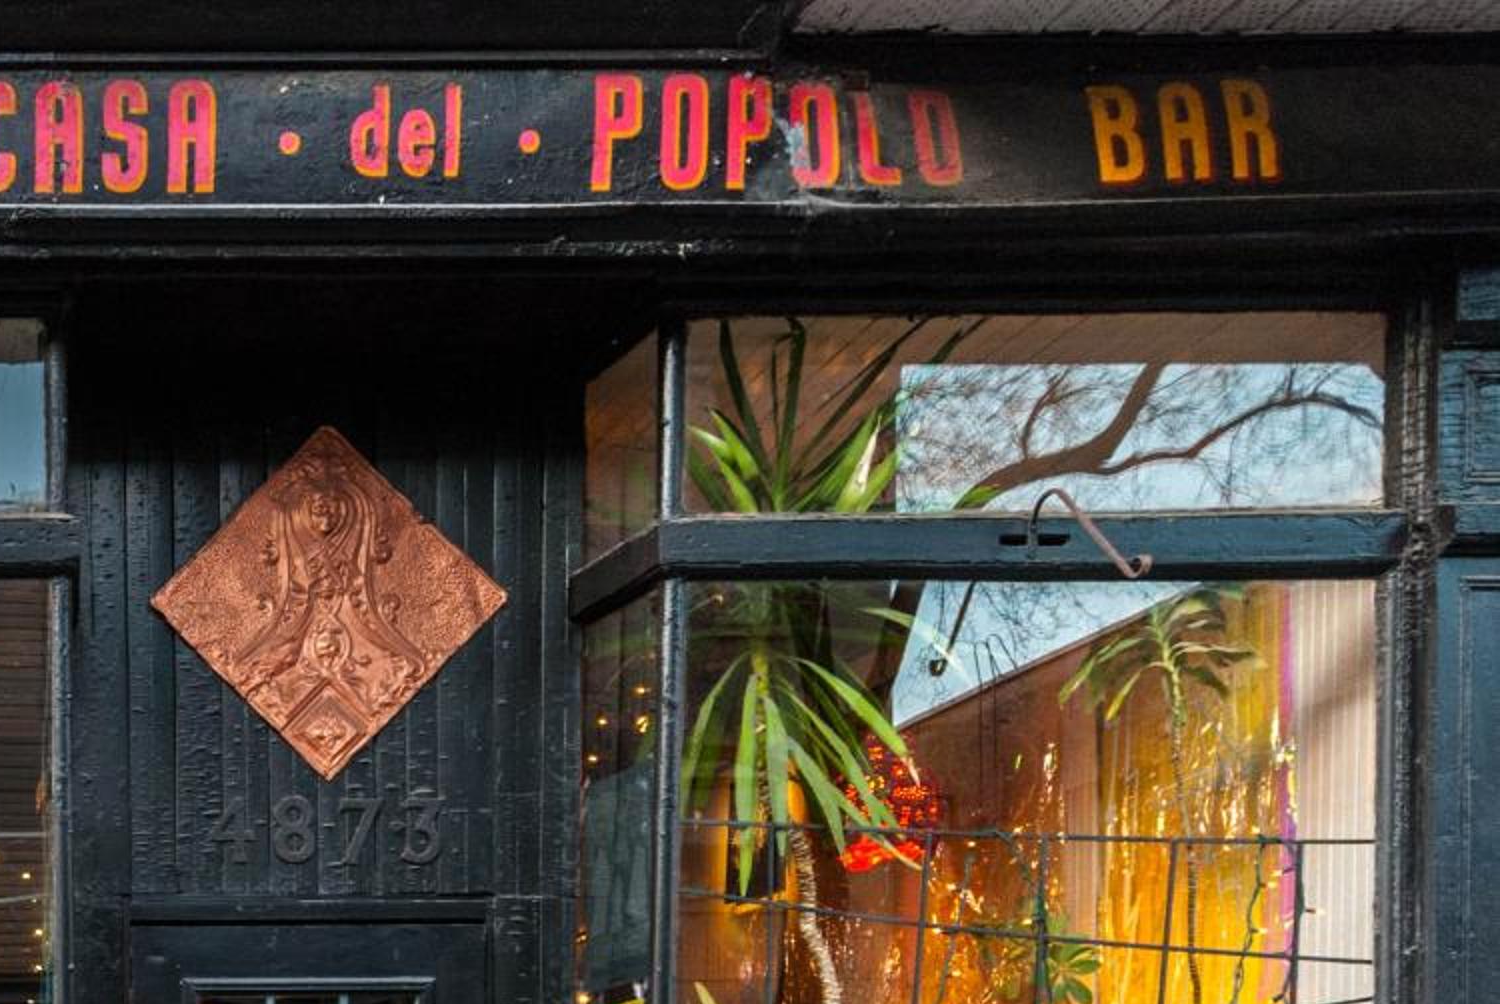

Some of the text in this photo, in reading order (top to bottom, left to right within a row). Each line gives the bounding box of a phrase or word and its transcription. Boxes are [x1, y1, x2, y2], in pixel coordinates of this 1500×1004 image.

[350, 83, 463, 178] del
[590, 70, 964, 192] POPOLO
[1084, 78, 1284, 183] BAR
[211, 794, 446, 866] 4873
